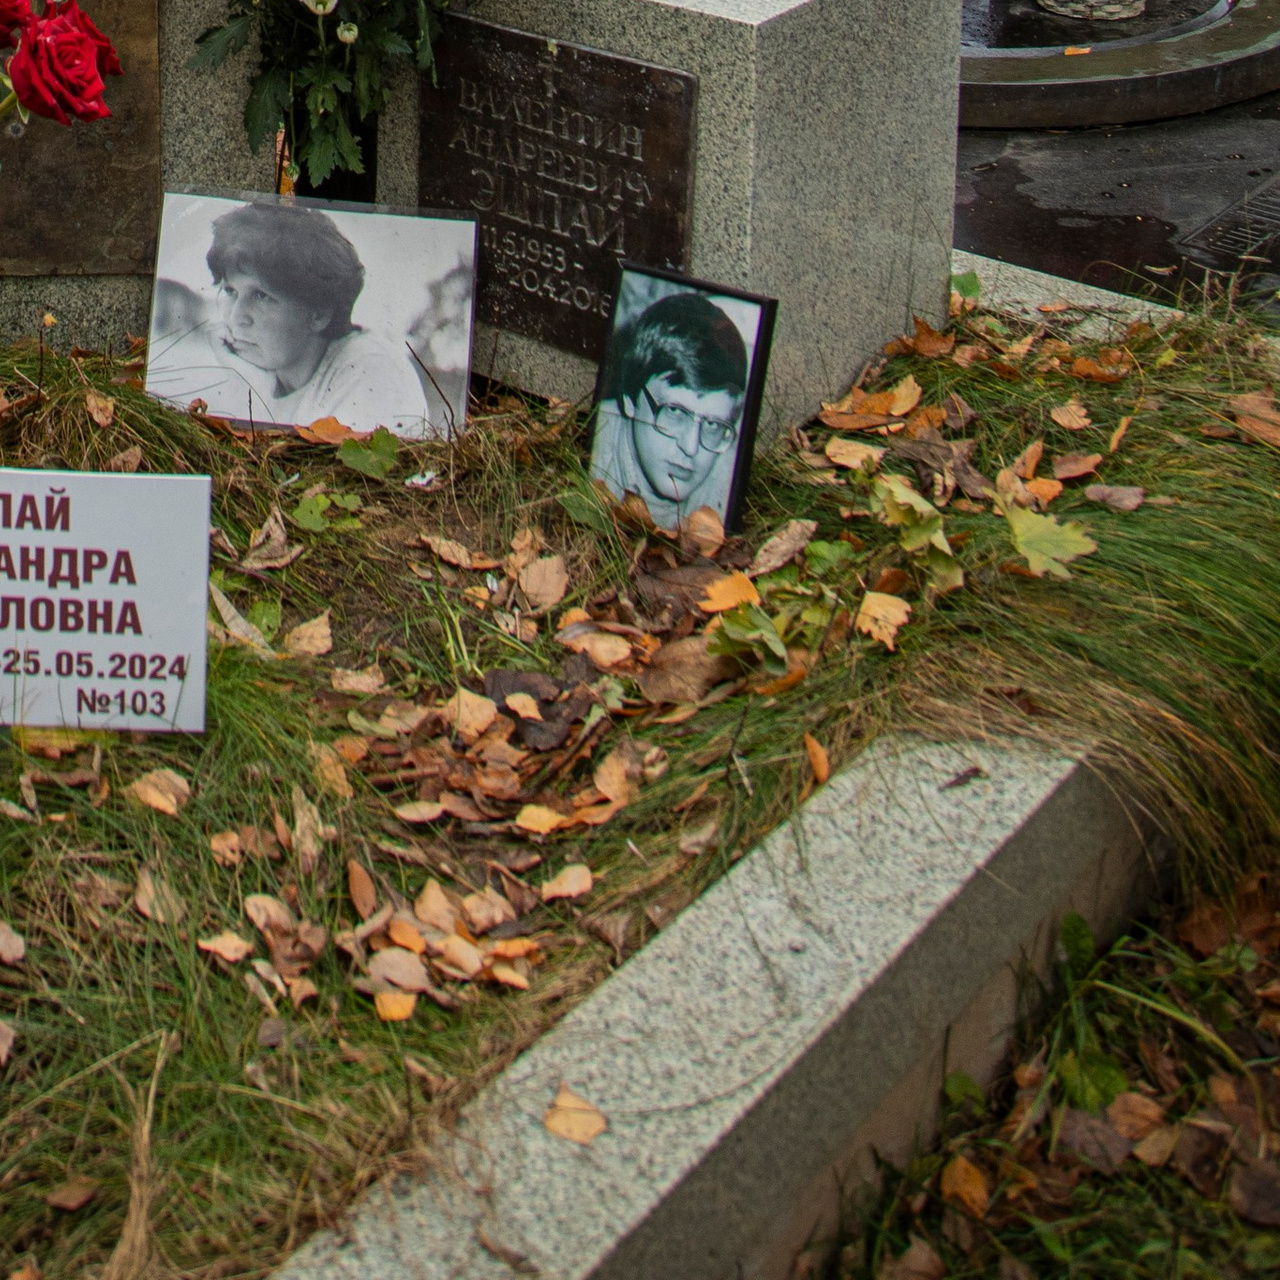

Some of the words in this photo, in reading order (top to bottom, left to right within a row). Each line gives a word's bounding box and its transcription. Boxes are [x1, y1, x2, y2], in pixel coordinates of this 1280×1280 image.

[459, 77, 645, 162] ВАЛЕНТИН
[470, 169, 627, 256] ЭШПАЙ
[77, 688, 166, 717] №103
